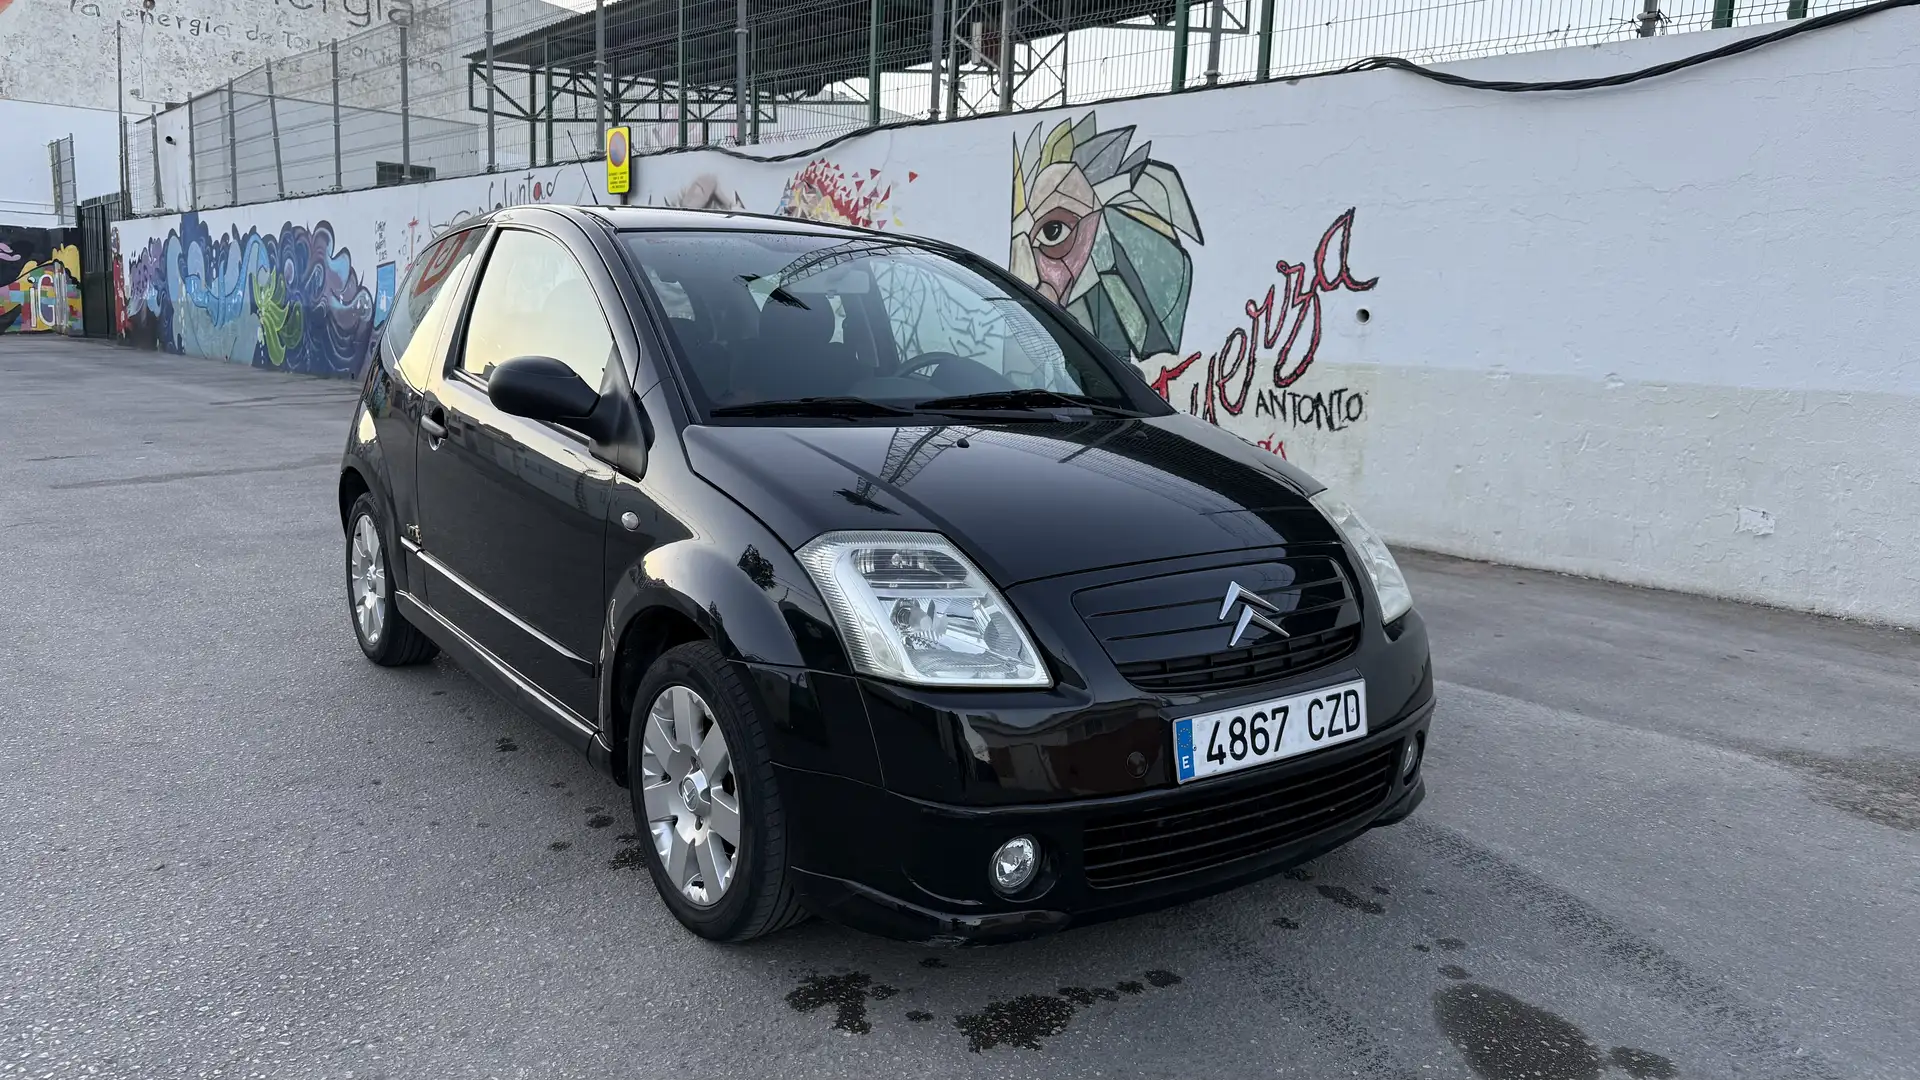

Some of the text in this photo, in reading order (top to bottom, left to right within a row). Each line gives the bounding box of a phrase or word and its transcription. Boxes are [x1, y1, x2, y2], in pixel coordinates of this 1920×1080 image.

[1206, 689, 1361, 765] 4867 CZD
[1182, 755, 1190, 770] E
